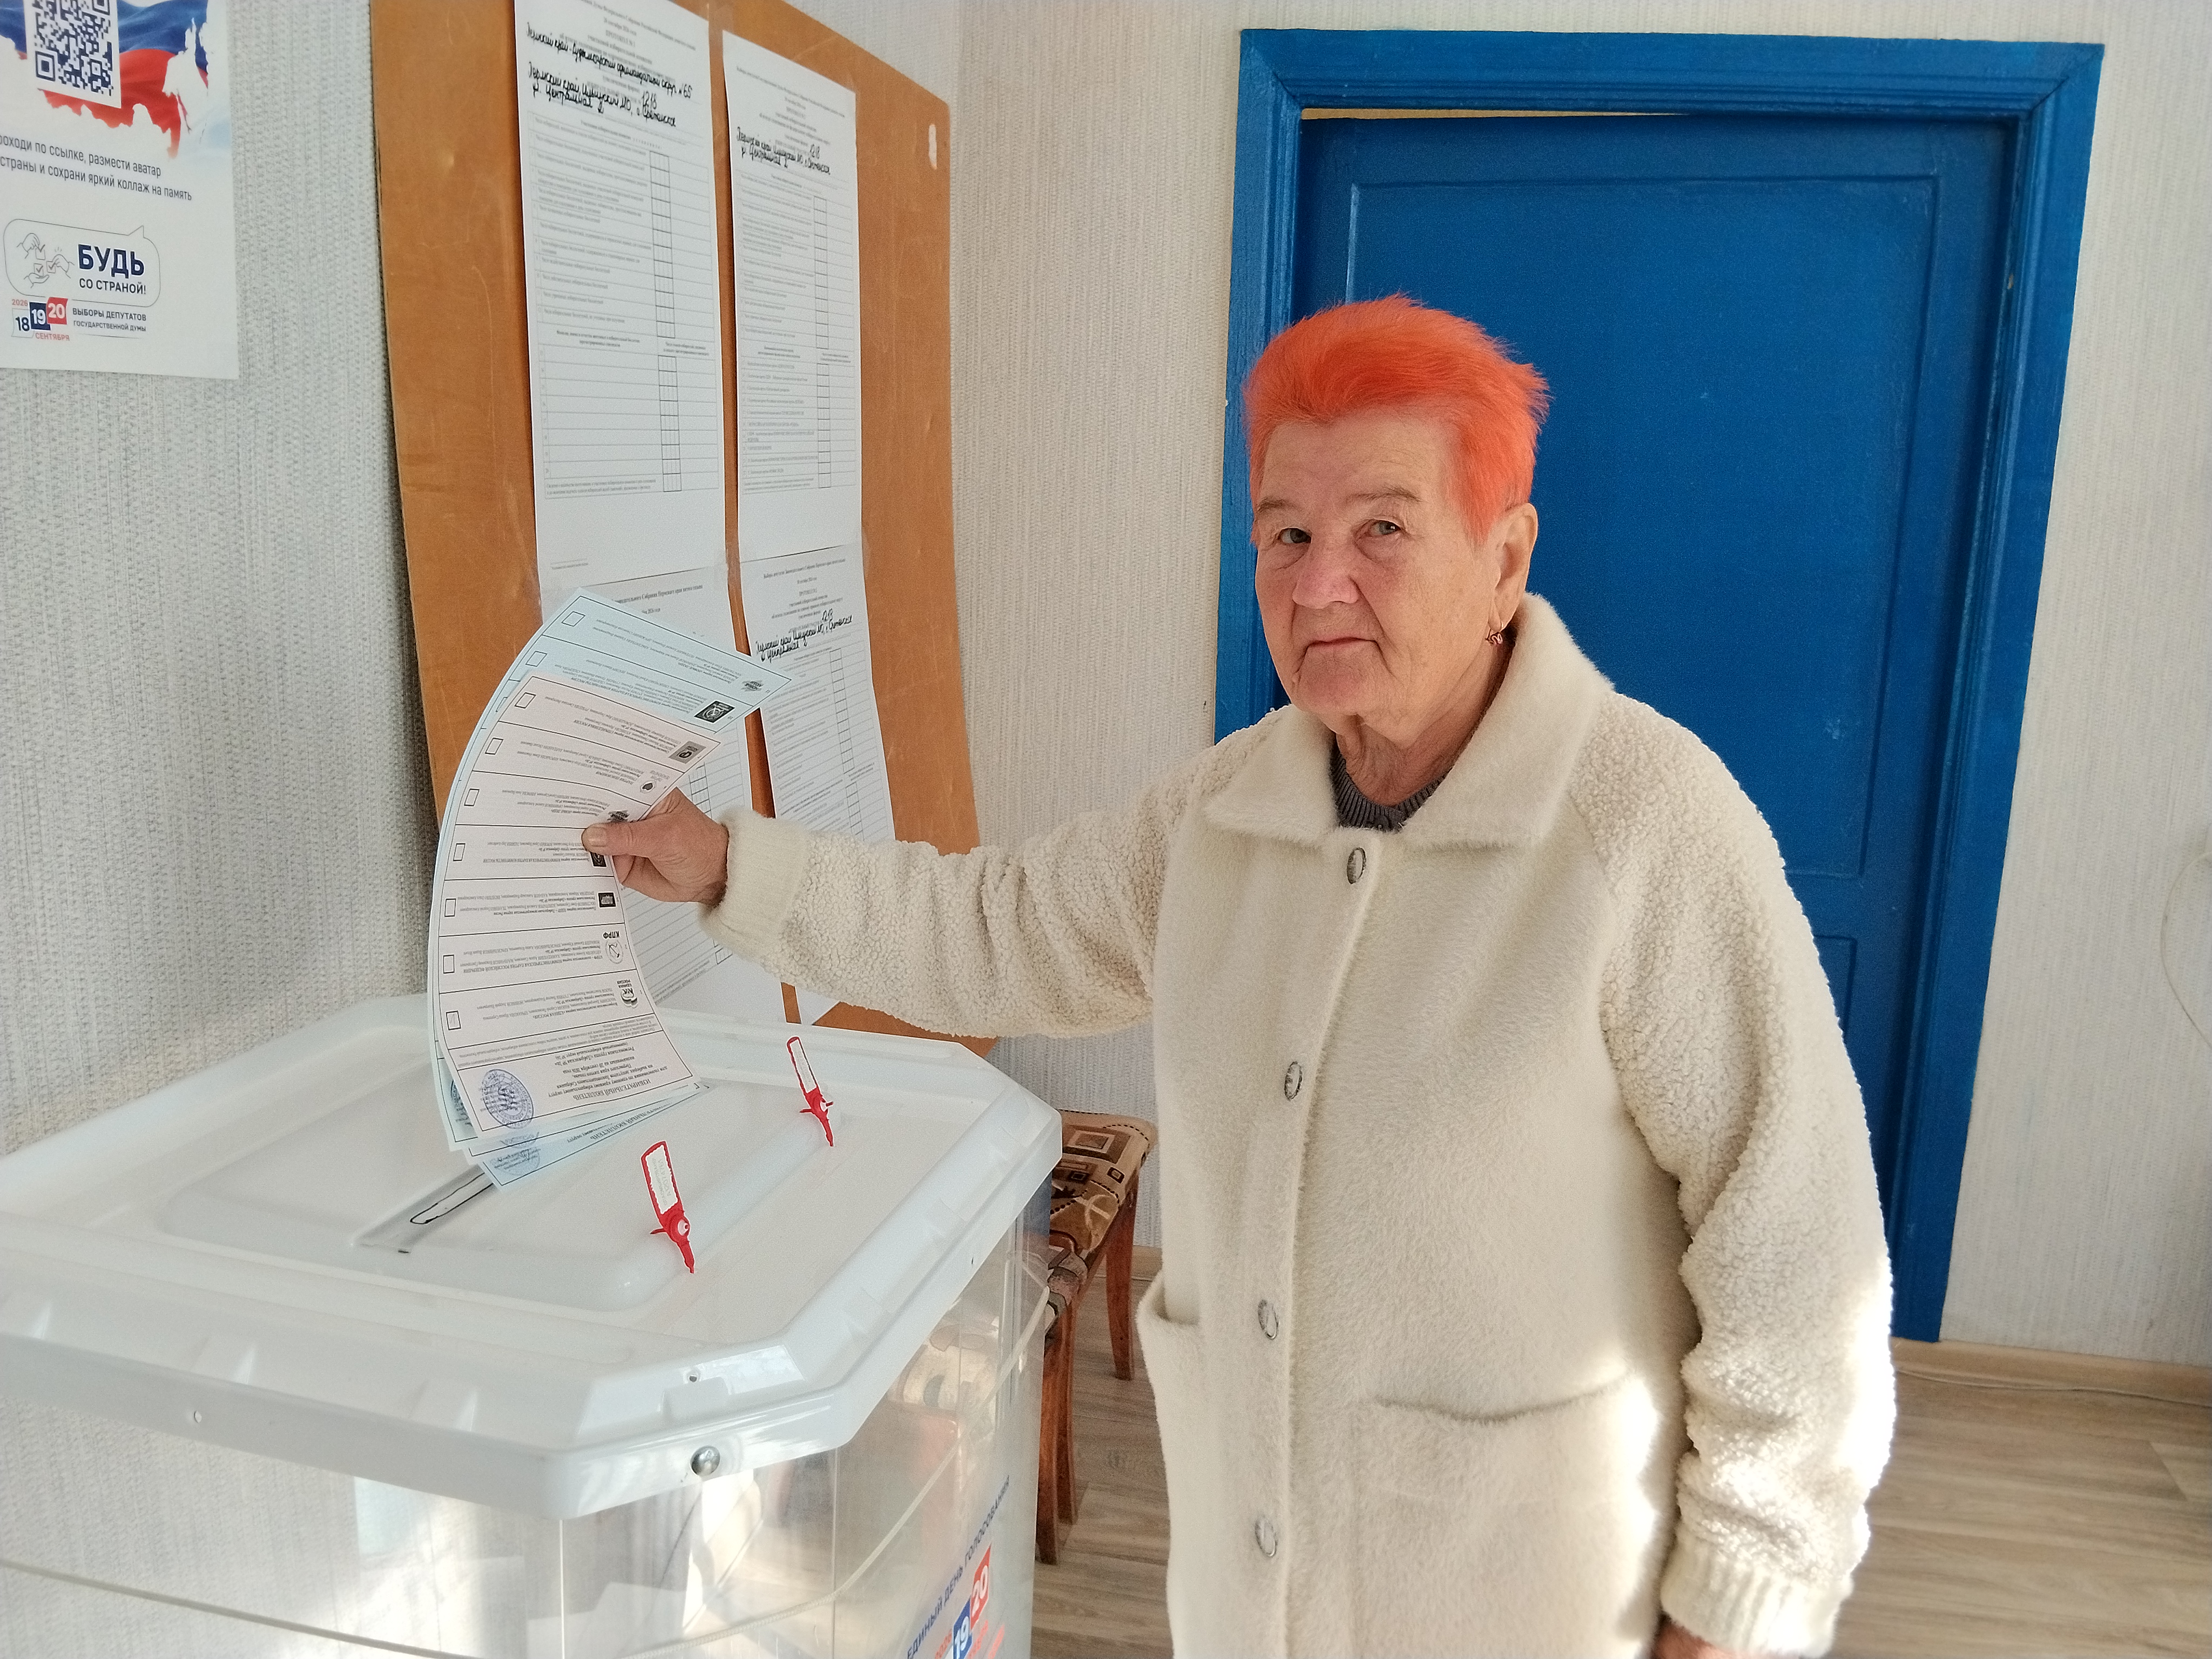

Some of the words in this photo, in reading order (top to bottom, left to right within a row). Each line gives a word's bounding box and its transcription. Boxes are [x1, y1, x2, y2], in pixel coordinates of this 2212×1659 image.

[35, 142, 46, 154] по
[50, 145, 86, 165] ссылке,
[89, 153, 130, 171] размести
[133, 161, 161, 179] аватар
[0, 156, 36, 173] страны
[39, 164, 45, 174] и
[49, 165, 85, 182] сохрани
[89, 173, 115, 187] яркий
[118, 179, 150, 193] коллаж
[152, 185, 161, 195] на
[164, 187, 192, 201] память
[78, 244, 145, 279] БУДЬ
[79, 278, 93, 289] СО
[96, 281, 146, 295] СТРАНОЙ!
[15, 316, 30, 332] 18
[31, 308, 46, 325] 19
[48, 304, 65, 319] 20
[72, 308, 104, 318] ВЫБОРЫ
[106, 311, 146, 321] ДЕПУТАТОВ
[73, 321, 129, 331] ГОСУДАРСТВЕННОЙ
[36, 333, 70, 341] СЕНТЯБРЯ
[602, 930, 619, 940] КПРФ
[572, 1088, 604, 1102] БЮЛЛЕТЕНЬ
[603, 1078, 651, 1096] ИЗБИРАТЕЛЬНЫЙ
[589, 1123, 626, 1141] БЮЛЛЕТЕНЬ
[972, 1564, 989, 1617] 20
[907, 1596, 943, 1659] ЕДИНЫЙ
[945, 1566, 963, 1606] ДЕНЬ
[954, 1616, 969, 1659] 19
